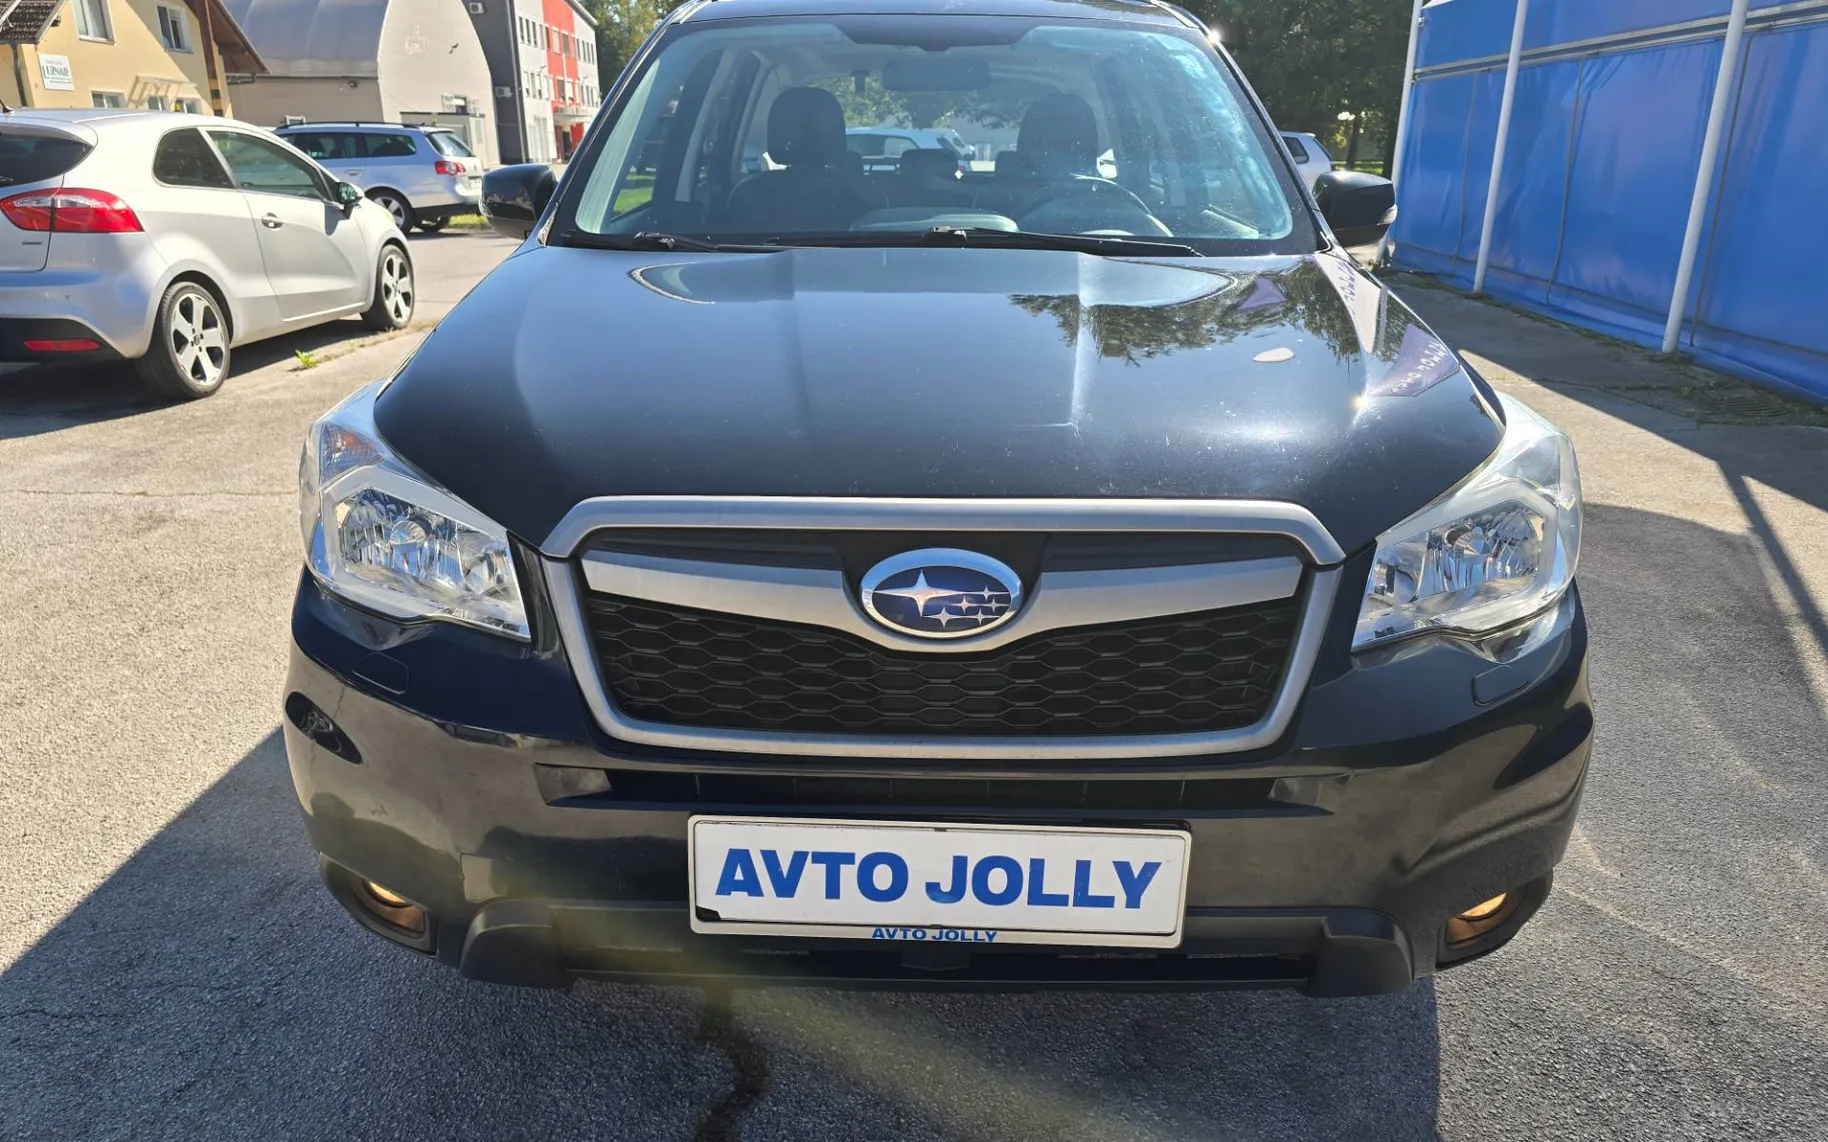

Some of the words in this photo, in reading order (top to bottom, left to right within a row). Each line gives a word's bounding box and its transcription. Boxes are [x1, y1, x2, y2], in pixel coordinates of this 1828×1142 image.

[715, 847, 909, 903] AVTO
[924, 854, 1162, 910] JOLLY
[872, 927, 927, 941] AVTO
[932, 928, 998, 943] JOLLY
